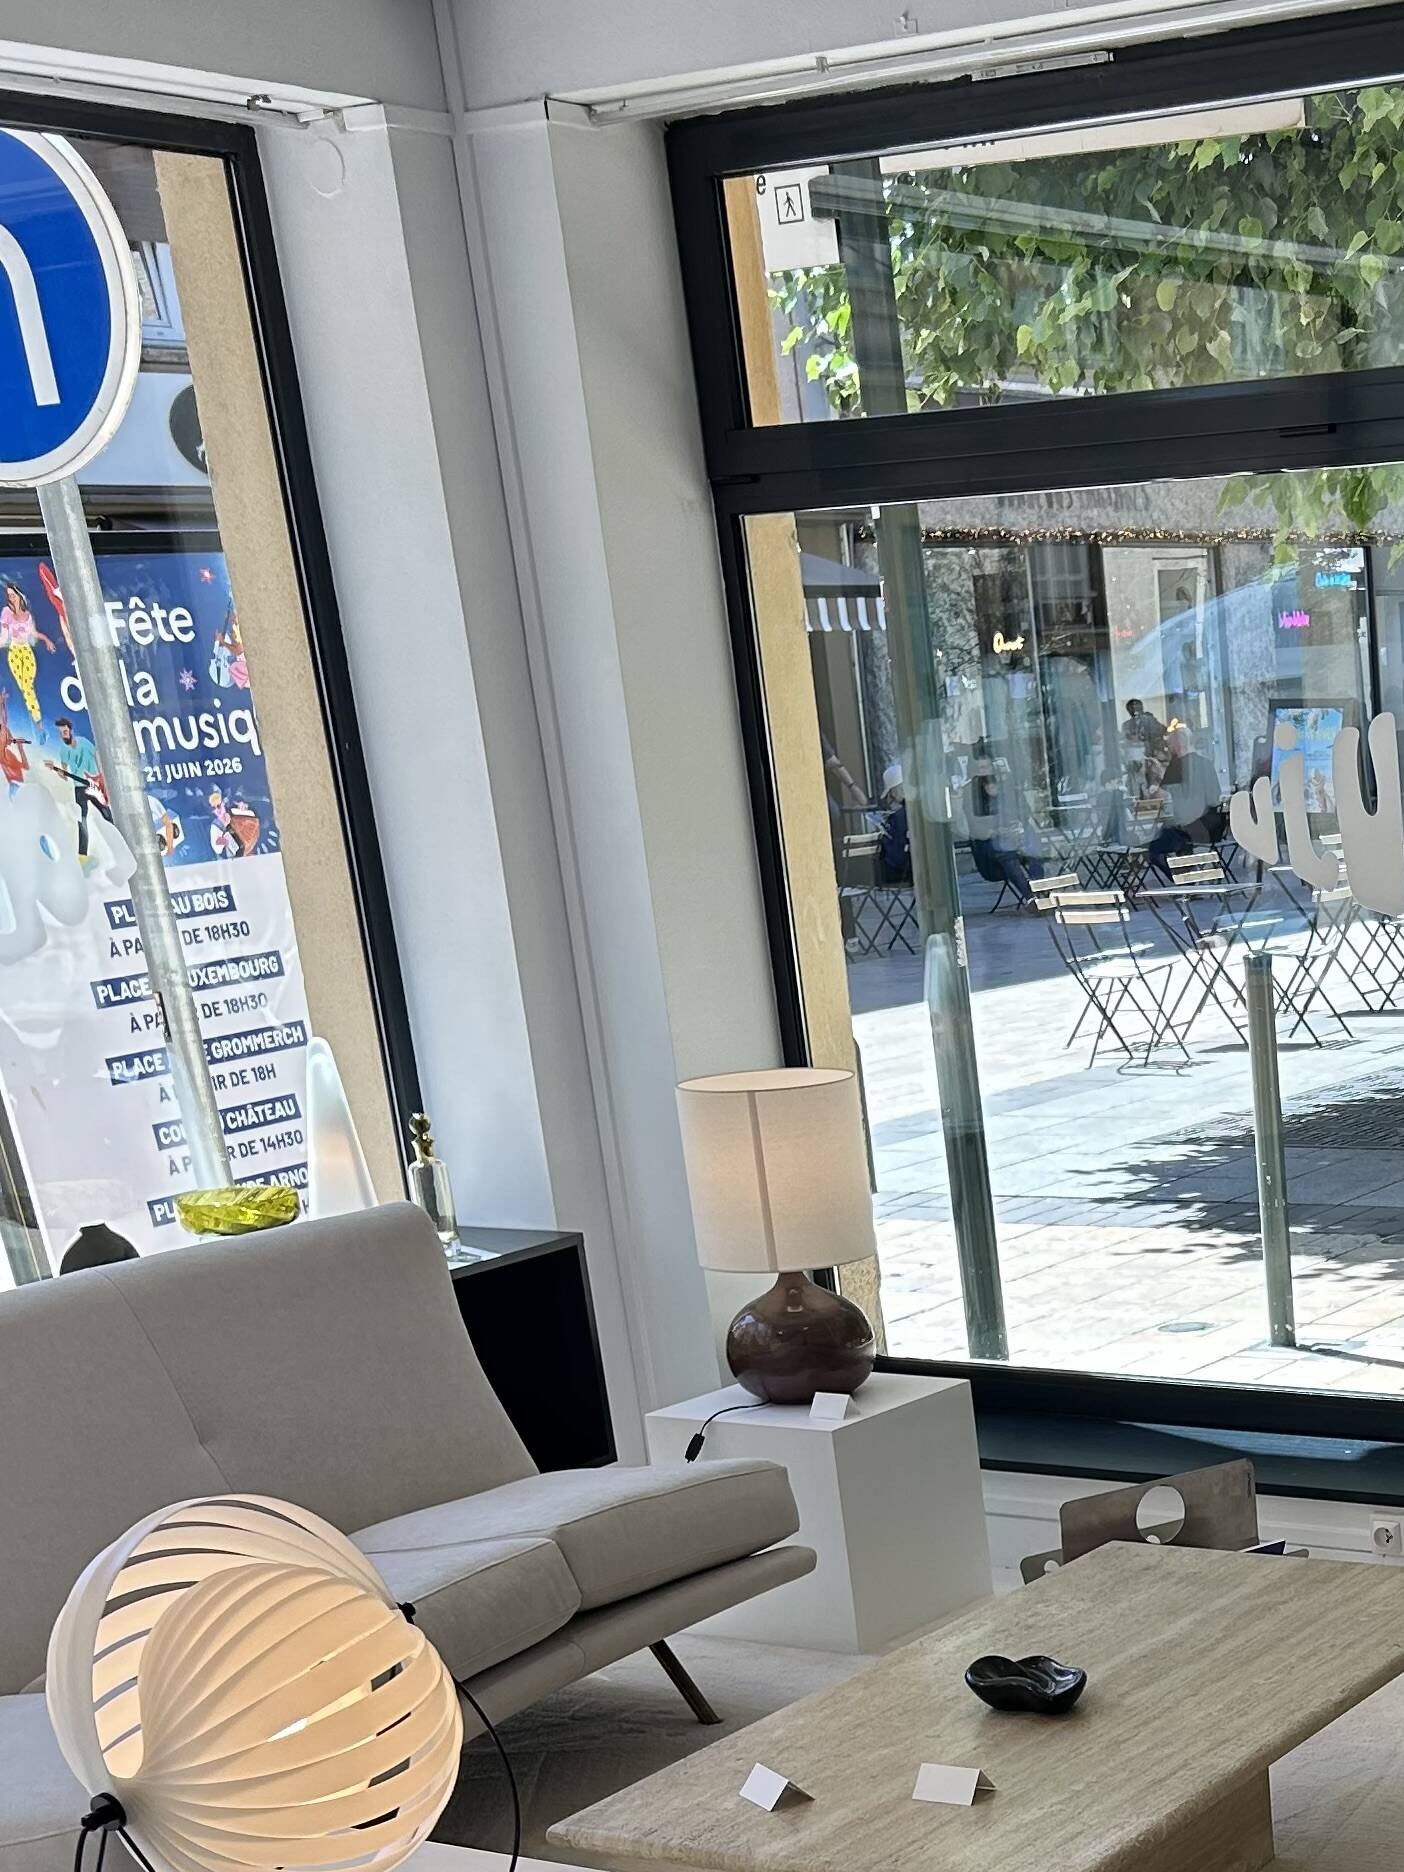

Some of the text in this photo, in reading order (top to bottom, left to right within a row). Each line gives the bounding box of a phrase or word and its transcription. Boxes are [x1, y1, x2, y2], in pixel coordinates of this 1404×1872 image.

[103, 596, 196, 647] Fête
[60, 661, 90, 712] d
[145, 757, 243, 784] 21 JUIN 2026
[192, 890, 229, 912] BOIS
[182, 928, 204, 946] DE
[204, 920, 251, 942] 18H30
[97, 956, 279, 1004] PLACE UXEMBOURG
[202, 1001, 221, 1018] DE
[224, 992, 269, 1015] 18H30
[111, 1052, 165, 1080] PLACE
[212, 1024, 304, 1060] GROMMERCH
[231, 1069, 250, 1087] DE
[251, 1063, 277, 1083] 18H
[226, 1097, 296, 1129] CHÂTEAU
[239, 1139, 259, 1158] DE
[261, 1129, 304, 1153] 14H30
